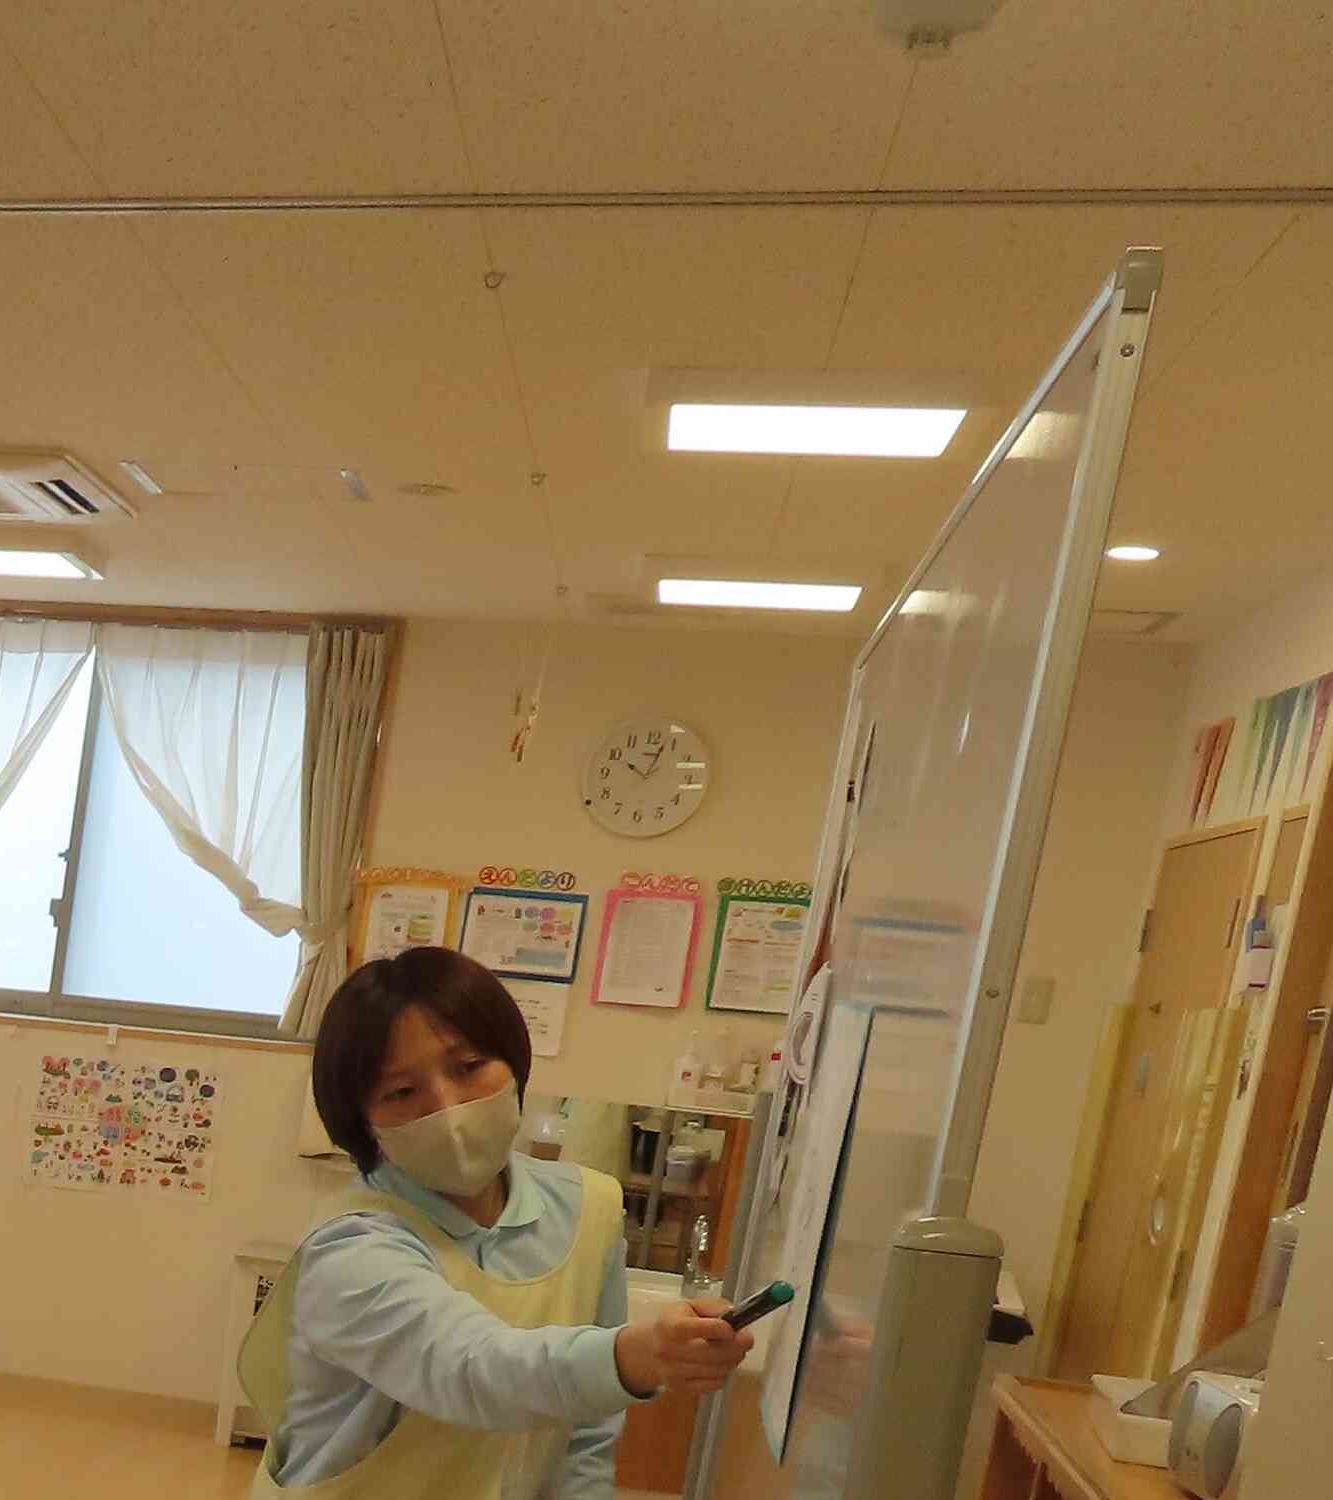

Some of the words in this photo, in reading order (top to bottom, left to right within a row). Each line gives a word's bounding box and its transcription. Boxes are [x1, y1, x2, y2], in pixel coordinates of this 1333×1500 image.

[627, 733, 638, 749] 11
[645, 731, 662, 745] 12
[608, 747, 623, 761] 10
[600, 766, 611, 780] 9
[600, 786, 611, 800] 8
[614, 802, 624, 816] 7
[632, 810, 643, 823] 6
